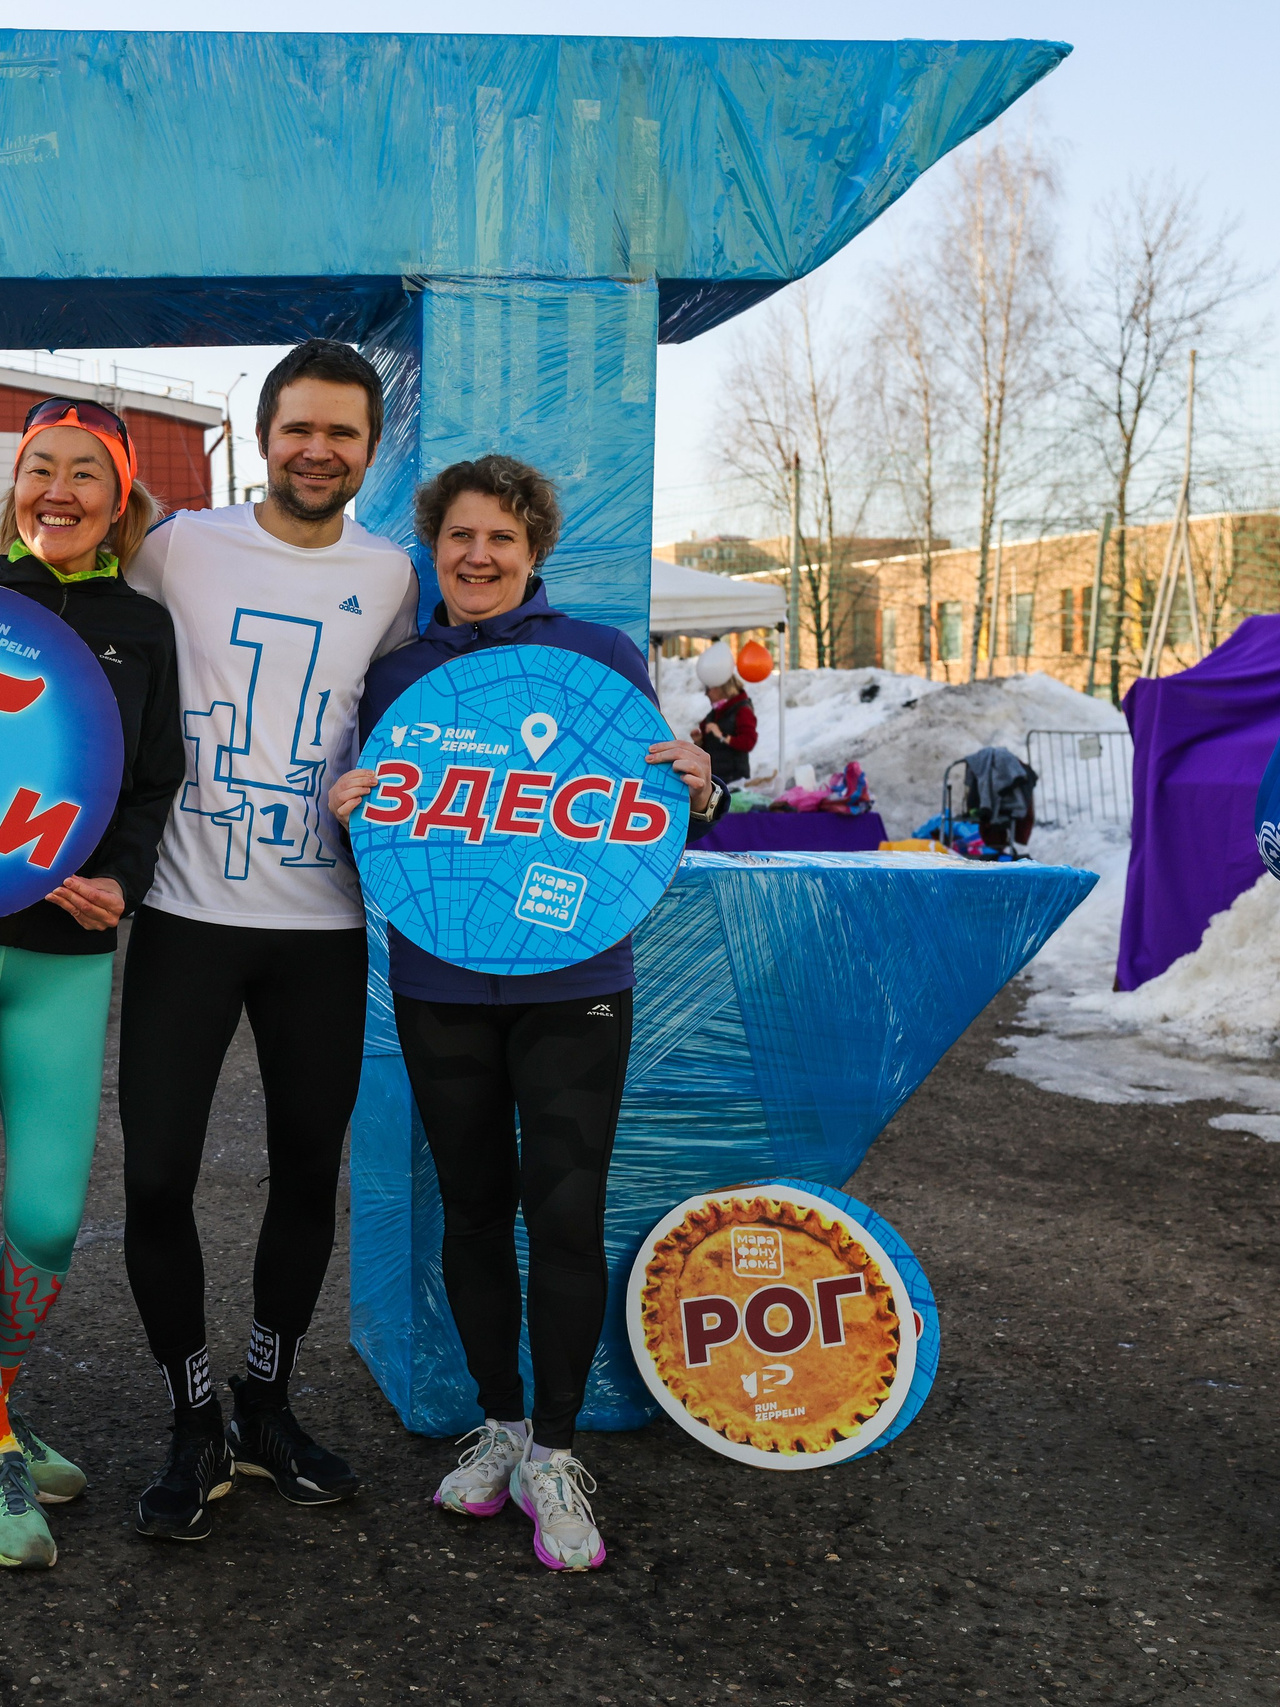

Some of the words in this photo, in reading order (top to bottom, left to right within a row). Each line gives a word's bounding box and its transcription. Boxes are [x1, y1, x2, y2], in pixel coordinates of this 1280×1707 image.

[339, 603, 363, 615] adidas
[444, 727, 477, 740] RUN
[439, 740, 509, 756] ZEPPELIN
[361, 759, 671, 846] ЗДЕСЬ
[532, 870, 577, 892] мара
[528, 883, 575, 909] фону
[521, 899, 569, 921] дома
[737, 1233, 775, 1246] мара
[737, 1245, 777, 1260] фону
[738, 1258, 777, 1270] дома
[679, 1272, 866, 1369] РОГ
[754, 1401, 777, 1413] RUN
[755, 1406, 806, 1422] ZEPPELIN
